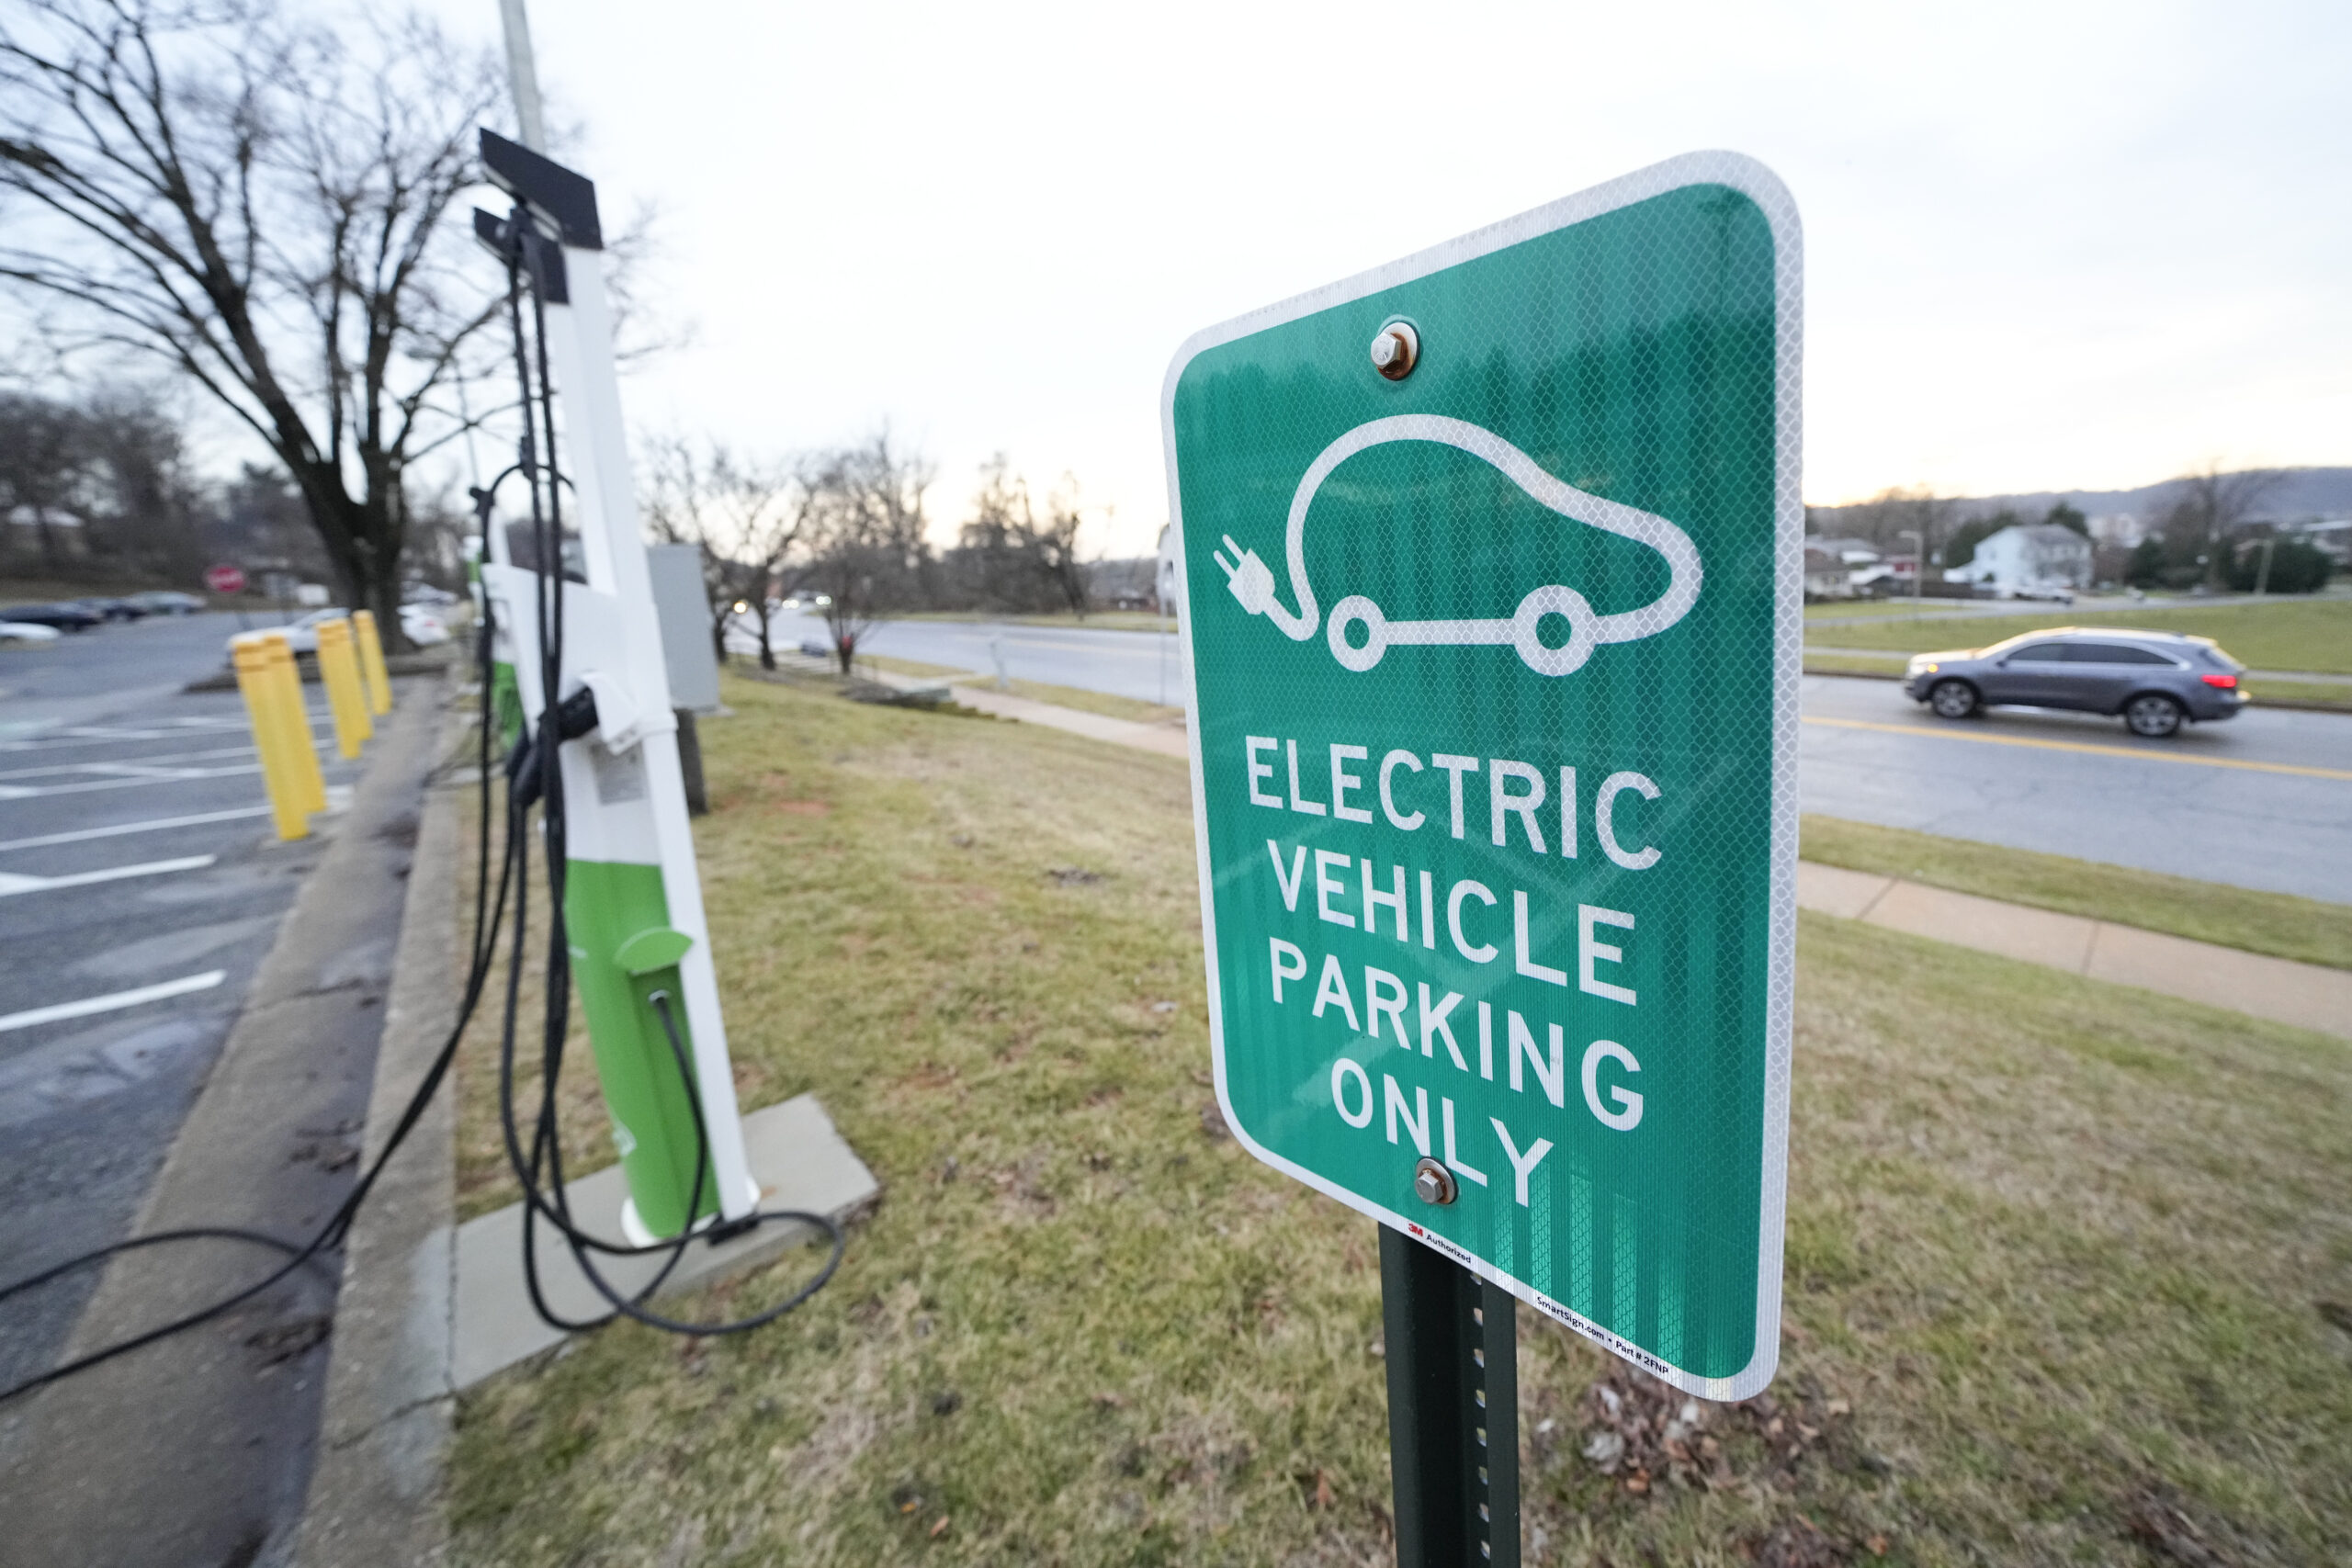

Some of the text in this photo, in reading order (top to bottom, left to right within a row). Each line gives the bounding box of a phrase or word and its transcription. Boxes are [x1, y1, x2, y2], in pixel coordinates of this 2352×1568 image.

[1245, 735, 1663, 871] ELECTRIC
[1266, 839, 1637, 1007] VEHICLE
[1269, 936, 1645, 1132] PARKING
[1330, 1057, 1555, 1208] ONLY
[1408, 1223, 1472, 1264] 3M Authorized
[1537, 1296, 1605, 1341] SmartSign.com
[1616, 1341, 1634, 1358] Part
